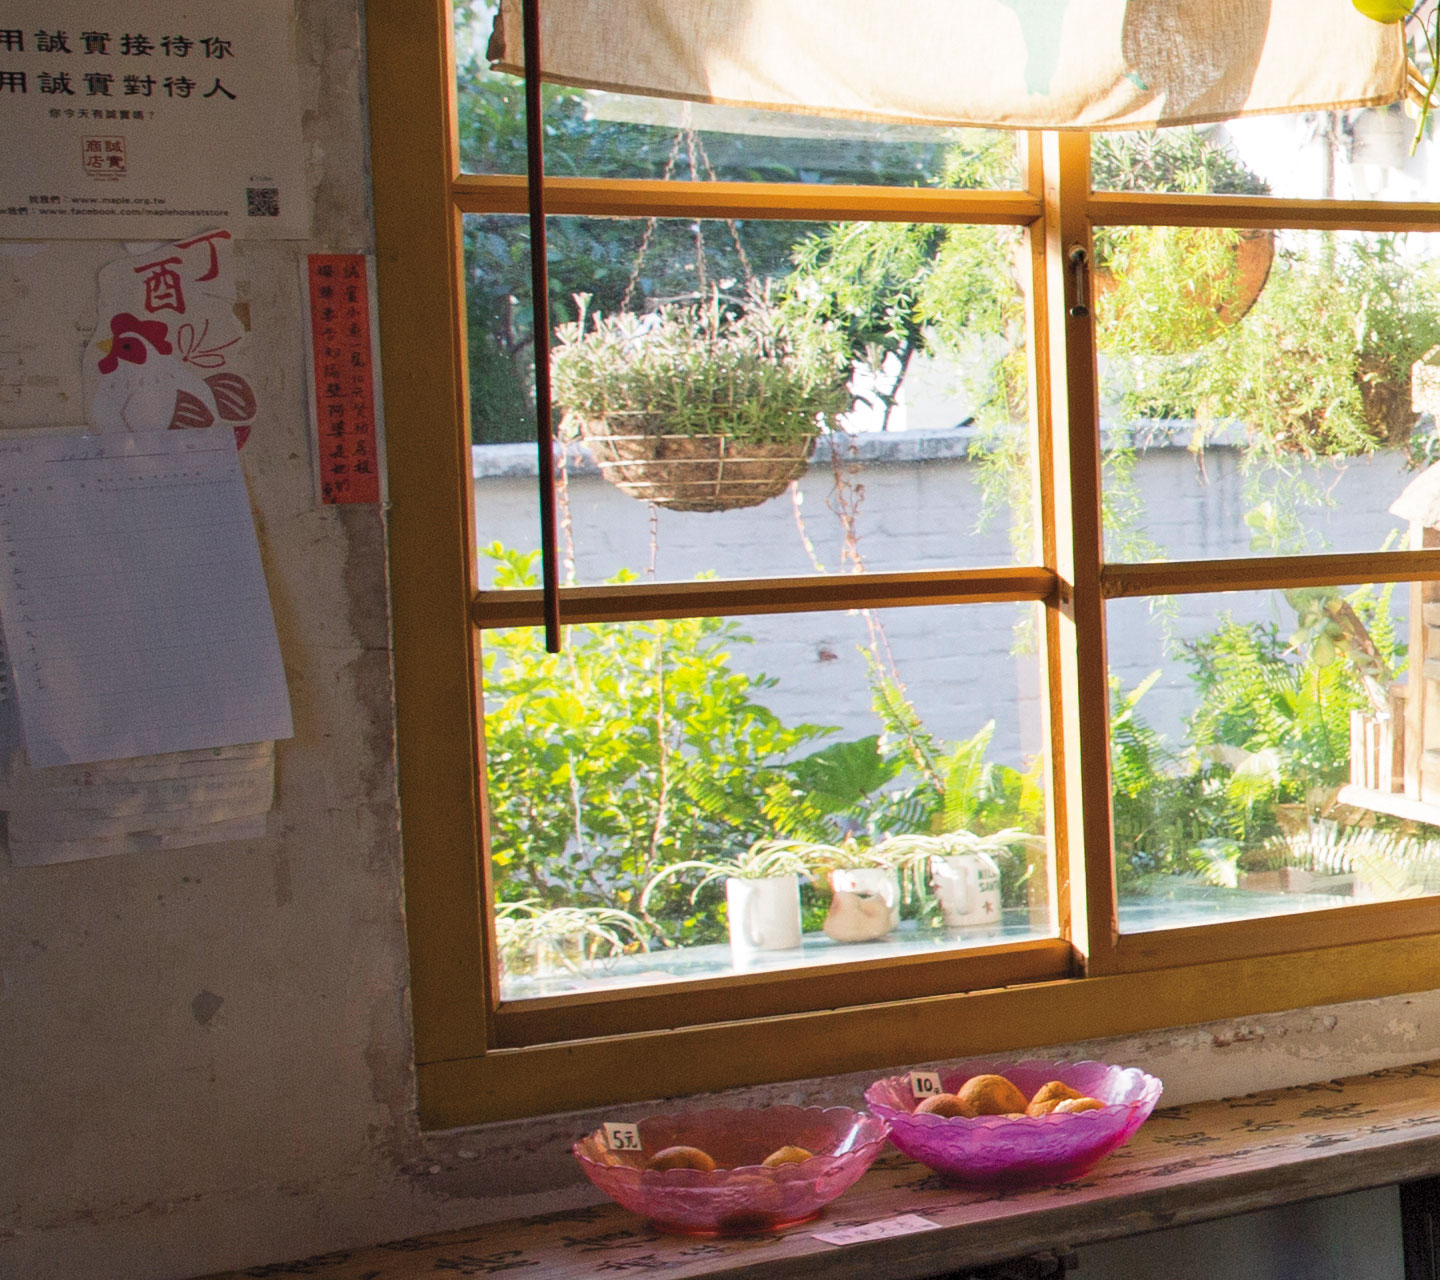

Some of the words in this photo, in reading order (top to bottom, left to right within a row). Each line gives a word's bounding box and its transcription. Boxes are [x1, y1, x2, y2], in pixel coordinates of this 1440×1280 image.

[0, 29, 235, 59] 用誠實接待你
[0, 71, 237, 101] 用誠實對待人
